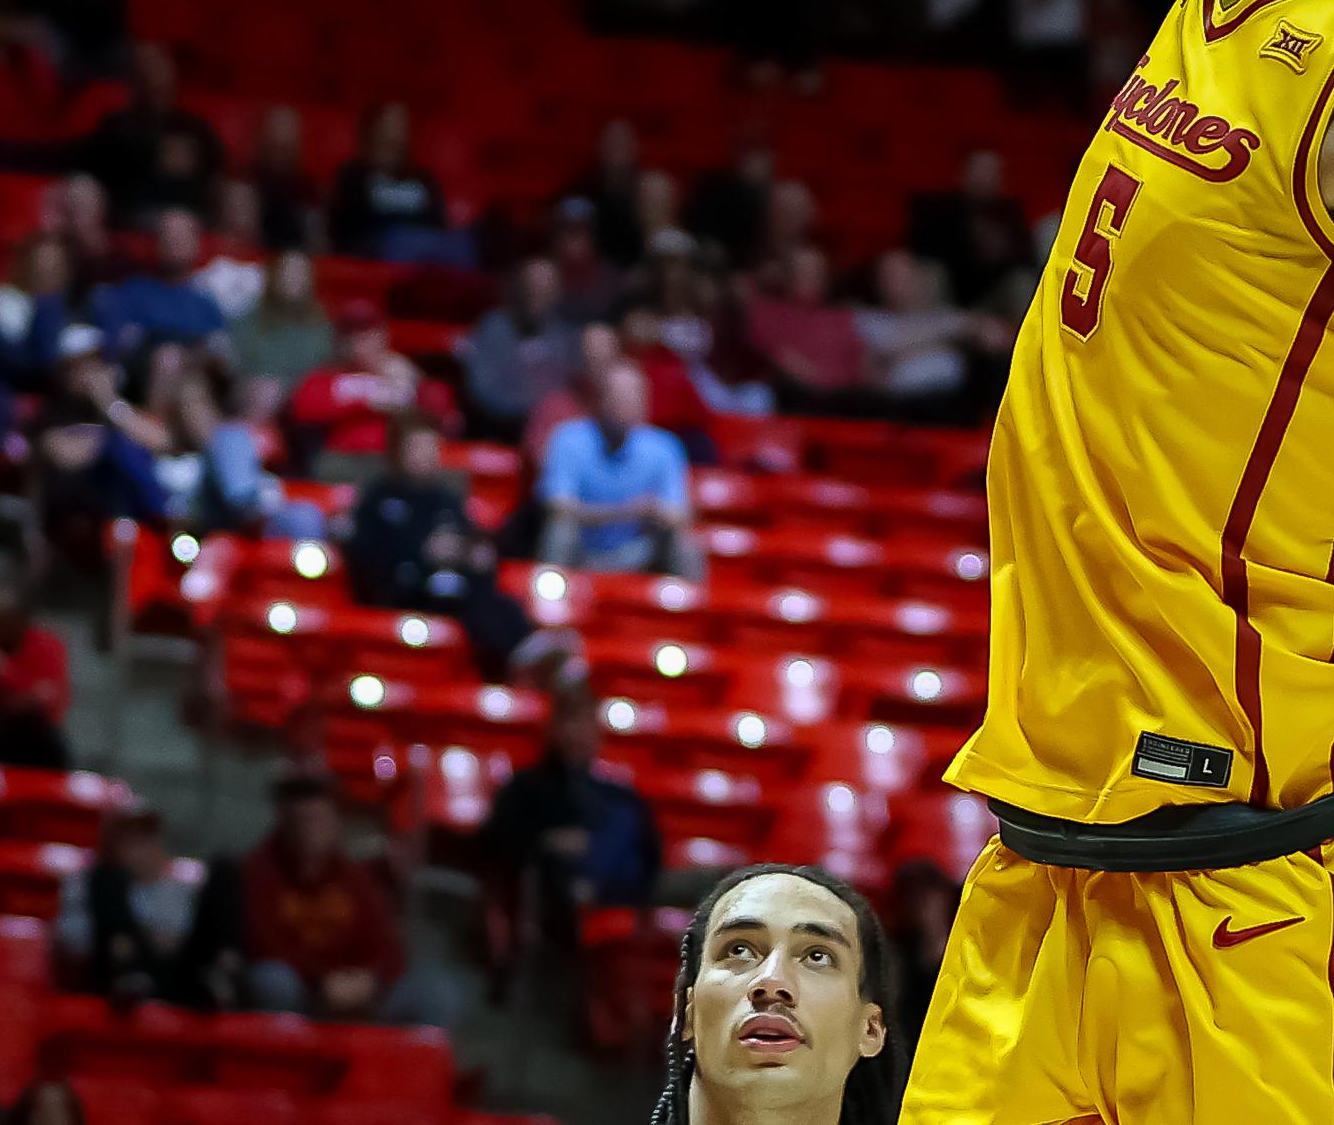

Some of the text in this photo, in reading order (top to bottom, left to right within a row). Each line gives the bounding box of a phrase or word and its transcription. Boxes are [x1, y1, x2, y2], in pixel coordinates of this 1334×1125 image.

[1104, 54, 1261, 182] yclones
[1060, 163, 1144, 342] 5
[1202, 757, 1213, 774] L
